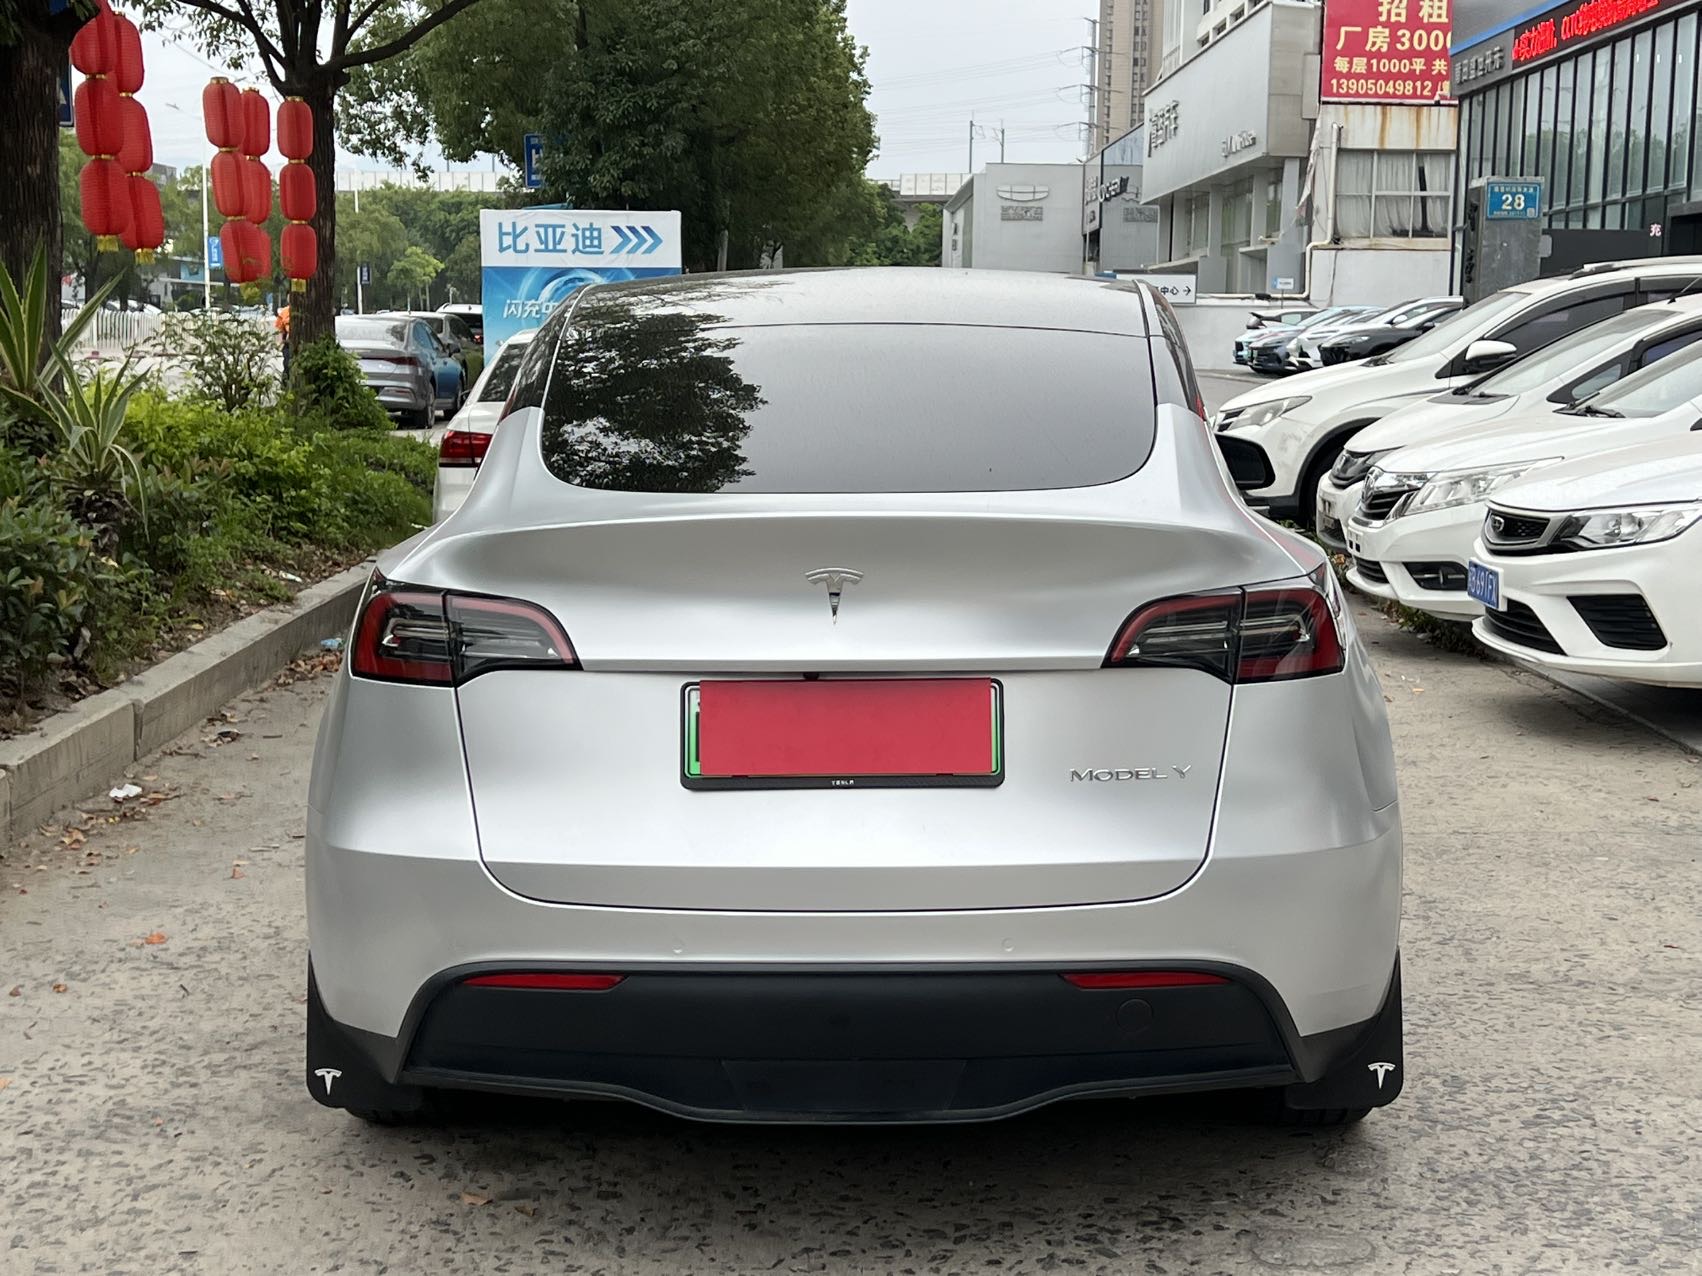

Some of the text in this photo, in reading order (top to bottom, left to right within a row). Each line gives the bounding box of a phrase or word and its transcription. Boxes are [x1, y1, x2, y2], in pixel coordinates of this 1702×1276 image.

[1378, 0, 1449, 23] 招租
[1334, 56, 1427, 75] 每层1000平
[1431, 59, 1449, 75] 共
[1330, 78, 1433, 96] 13905049812
[1501, 193, 1525, 210] 28
[497, 221, 605, 255] 比亚迪
[1069, 764, 1192, 782] MODEL Y
